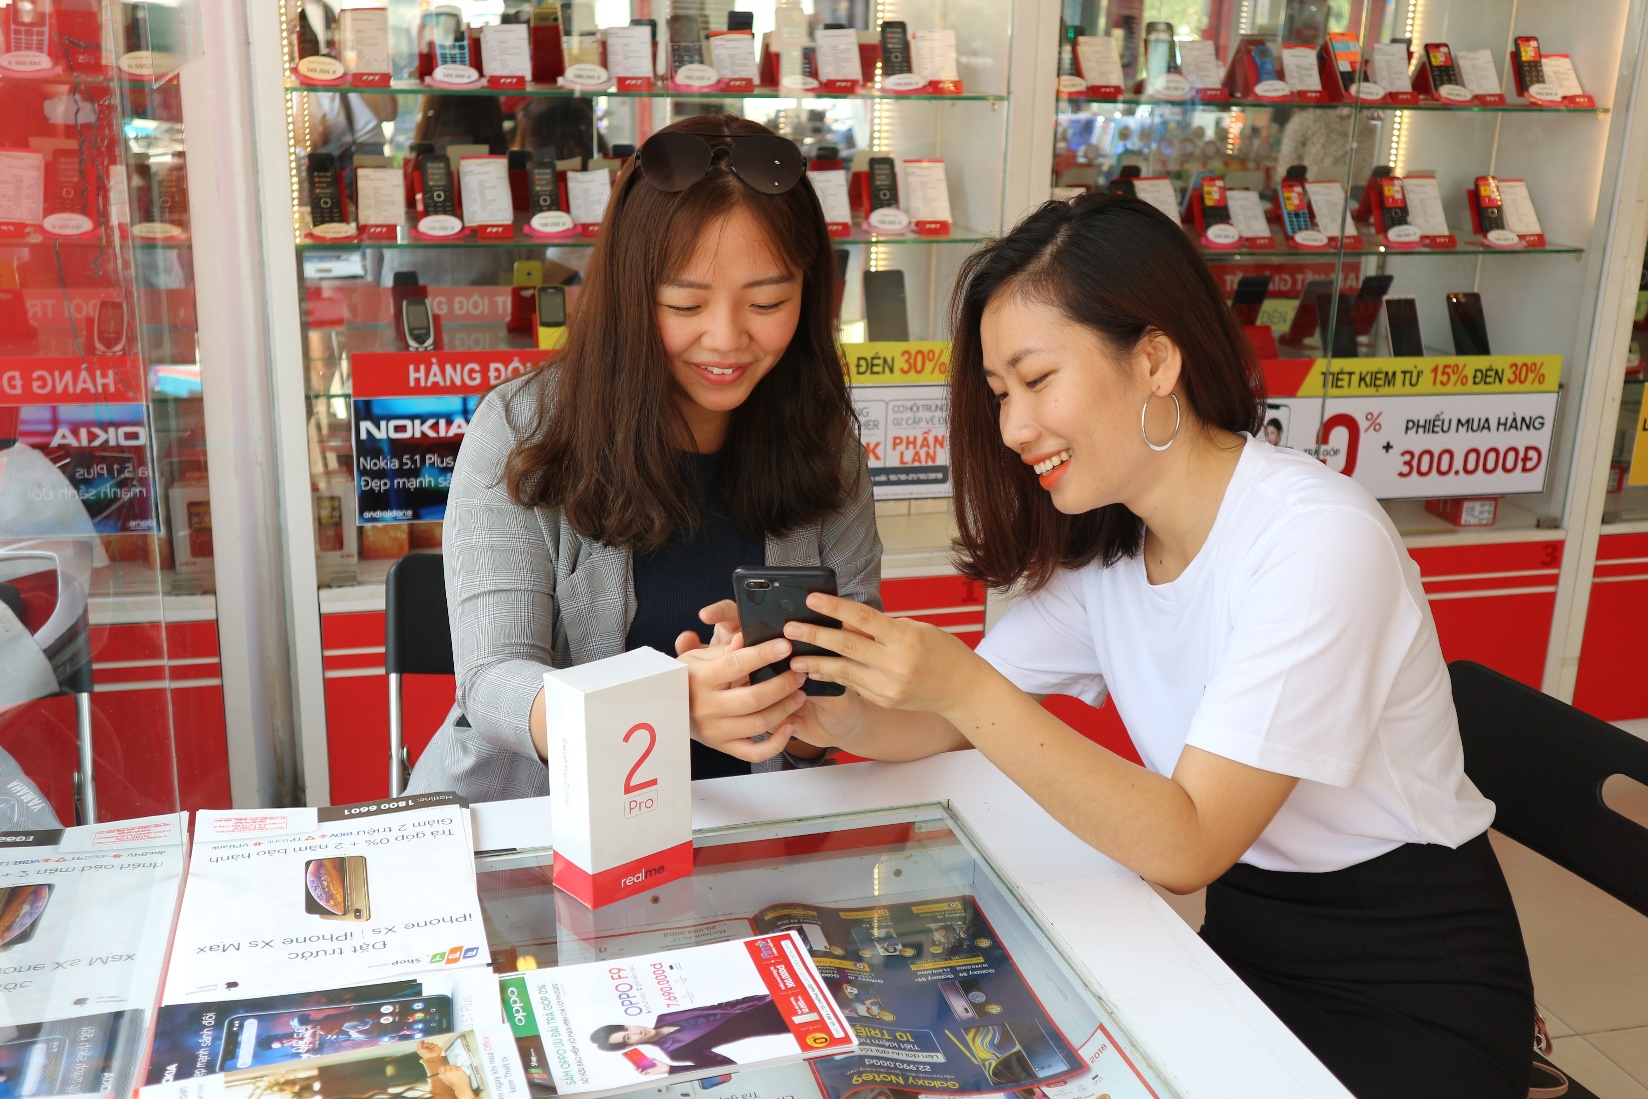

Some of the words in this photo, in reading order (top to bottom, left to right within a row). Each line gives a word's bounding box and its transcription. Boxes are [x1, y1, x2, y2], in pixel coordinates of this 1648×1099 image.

[856, 352, 895, 375] ĐẾN
[899, 349, 947, 375] 30%
[408, 357, 481, 388] HÀNG
[1321, 367, 1355, 389] TIẾT
[1358, 367, 1397, 393] KIỆM
[1400, 365, 1424, 388] TỪ
[1430, 363, 1469, 387] 15%
[1471, 366, 1504, 386] ĐẾN
[1507, 361, 1546, 386] 30%
[359, 418, 470, 440] NOKIA
[1404, 412, 1451, 436] PHIẾU
[1456, 419, 1491, 434] MUA
[1497, 412, 1546, 432] HÀNG
[892, 429, 945, 451] PHẦN
[359, 454, 399, 471] Nokia
[402, 453, 422, 469] 5.1
[425, 453, 454, 469] Plus
[899, 450, 937, 465] LAN
[1397, 445, 1543, 479] 300.000Đ
[360, 475, 391, 493] Đẹp
[394, 473, 434, 492] mạnh
[363, 508, 413, 520] androidone
[1540, 543, 1559, 567] 3
[622, 722, 658, 795] 2
[381, 799, 415, 810] 1800
[417, 794, 453, 803] Hotline:
[344, 805, 377, 816] 6601
[628, 797, 654, 815] Pro
[398, 824, 407, 832] 2
[412, 817, 453, 828] Giảm
[357, 825, 392, 836] triệu
[395, 832, 426, 843] góp
[431, 828, 455, 838] Trả
[293, 844, 328, 853] năm
[333, 842, 344, 850] 2
[365, 837, 389, 846] 0%
[209, 852, 251, 864] hành
[257, 847, 287, 857] bảo
[620, 864, 665, 889] realme
[404, 913, 473, 930] iPhone
[371, 925, 397, 935] Xs
[248, 939, 275, 949] Xs
[282, 931, 353, 945] iPhone
[196, 942, 241, 954] Max
[352, 940, 387, 953] Đặt
[287, 947, 344, 961] trước
[429, 945, 480, 965] FPT
[391, 957, 422, 966] Shop
[608, 967, 629, 981] F9
[928, 973, 955, 981] Galaxy
[969, 968, 996, 976] Galaxy
[650, 962, 681, 1009] 7.690.000đ
[507, 987, 527, 1026] oppo
[615, 982, 643, 1017] OPPO
[204, 1011, 216, 1028] đôi
[200, 1029, 215, 1050] sánh
[483, 1034, 493, 1054] Office
[872, 1037, 898, 1049] kiệm
[895, 1032, 914, 1043] 10
[899, 1042, 920, 1051] Tiết
[1089, 1043, 1108, 1064] 2018
[196, 1048, 213, 1068] mạnh
[555, 1048, 572, 1072] OPPO
[864, 1058, 932, 1072] 22.990.000đ
[851, 1073, 905, 1085] Note9
[908, 1077, 959, 1089] Galaxy
